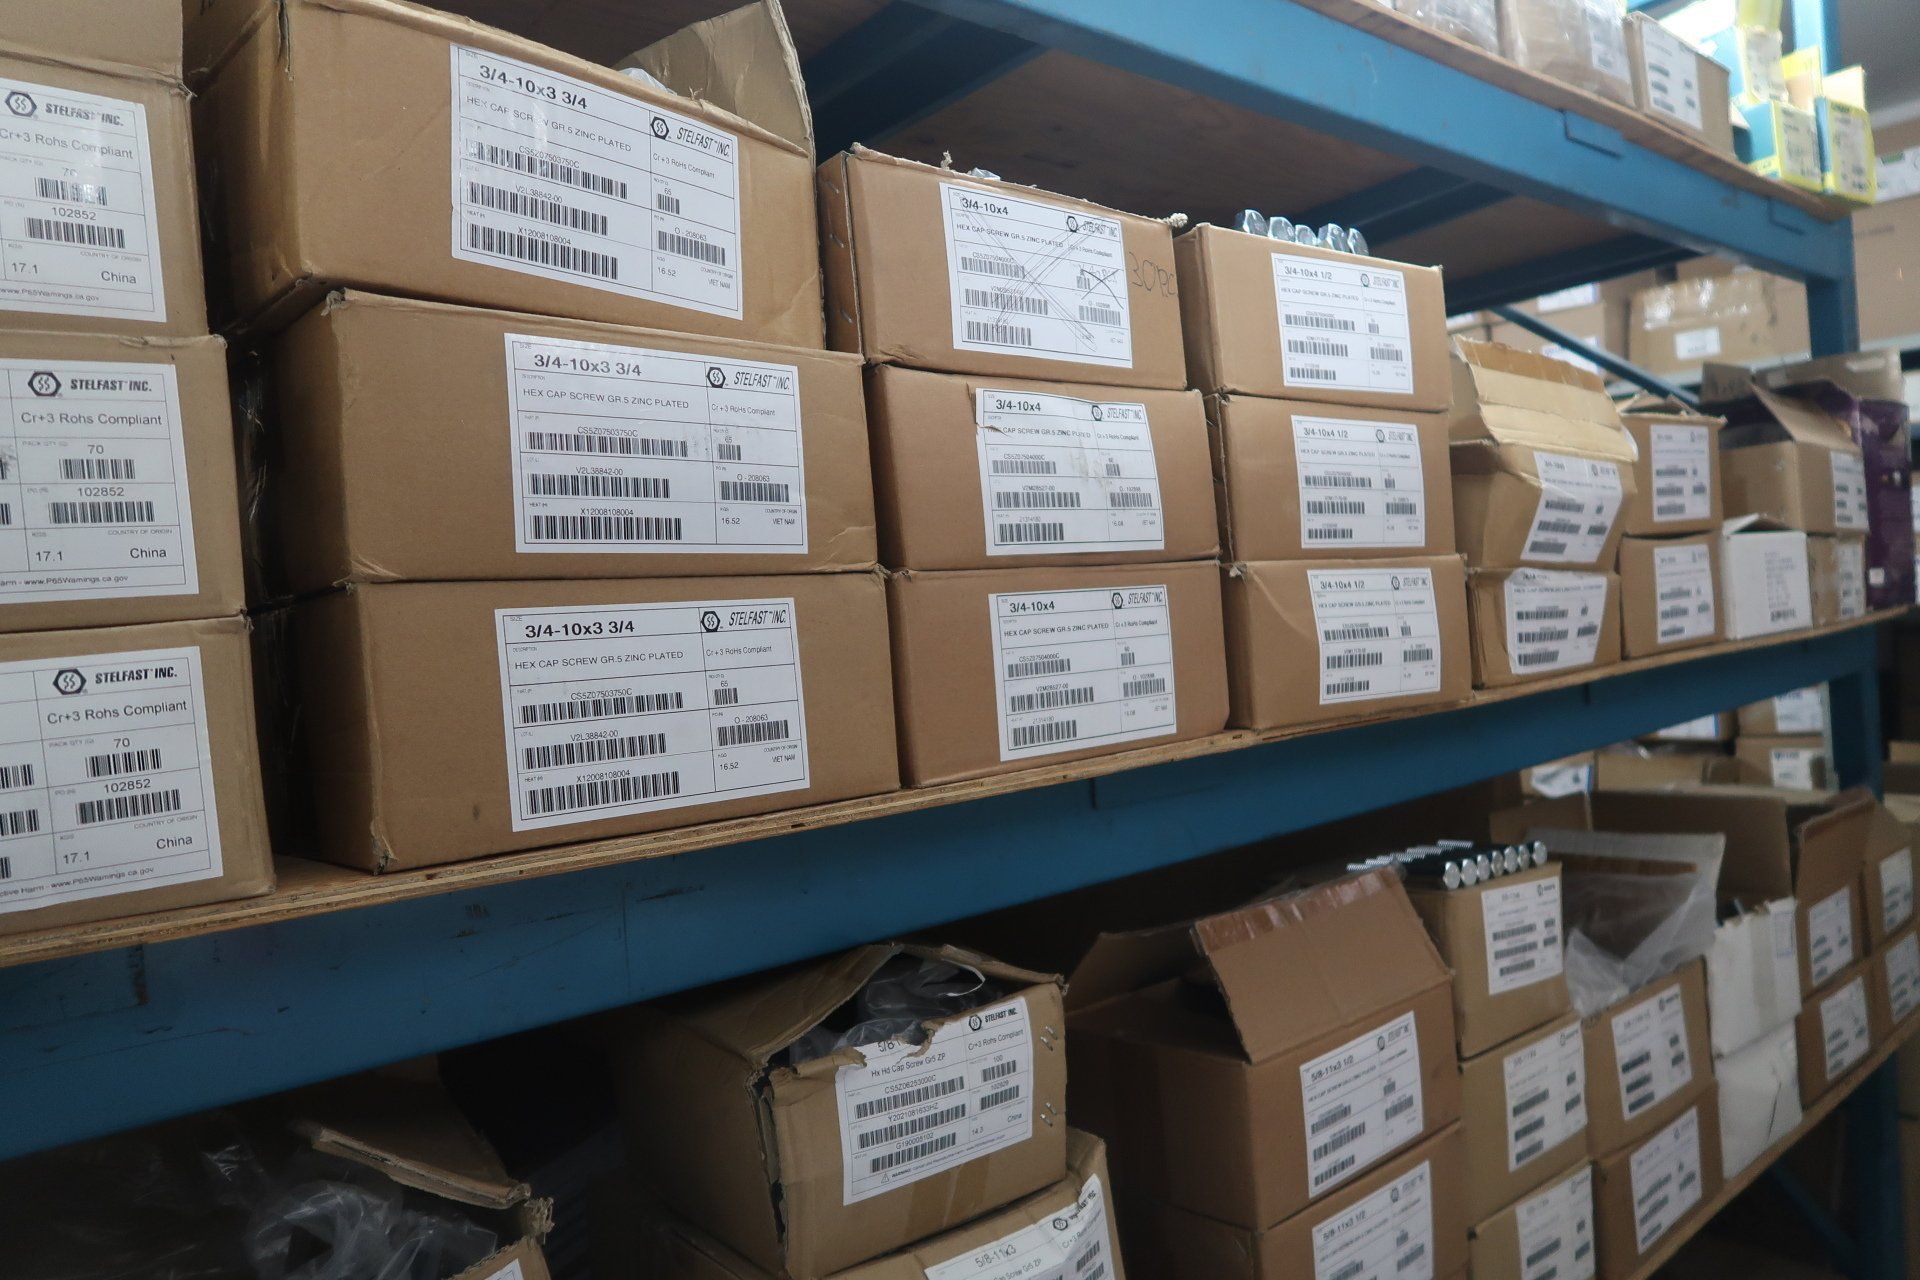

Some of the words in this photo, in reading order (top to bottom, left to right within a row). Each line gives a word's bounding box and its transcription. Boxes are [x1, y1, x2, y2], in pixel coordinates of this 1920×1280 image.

[480, 65, 556, 100] 3/4-10x3
[562, 91, 587, 109] 3/4
[101, 112, 124, 127] INC.
[467, 95, 488, 108] HEX
[575, 127, 596, 141] ZINC
[598, 135, 631, 152] PLATED
[35, 133, 68, 149] Rohs
[71, 138, 133, 159] Compliant
[677, 127, 714, 150] STELFAST
[716, 140, 730, 157] INC.
[653, 153, 661, 161] Cr
[671, 160, 687, 170] RoHs
[688, 164, 715, 179] Compliant
[962, 197, 1008, 216] 3/4-10x4
[51, 206, 96, 221] 102852
[957, 223, 970, 231] HEX
[987, 228, 1009, 238] SCREW
[1026, 236, 1040, 244] ZINC
[12, 262, 38, 274] 17.1
[657, 267, 676, 277] 16.52
[1285, 266, 1318, 278] 3/4-10x4
[1321, 271, 1332, 280] 1/2
[101, 270, 137, 284] China
[534, 354, 611, 373] 3/4-10x3
[616, 362, 642, 376] 3/4
[70, 379, 123, 391] STELFAST
[129, 380, 152, 392] INC.
[734, 371, 772, 388] STELFAST
[776, 377, 790, 390] INC.
[524, 389, 544, 397] HEX
[547, 390, 567, 398] CAP
[570, 391, 605, 402] SCREW
[632, 397, 653, 406] ZINC
[655, 399, 689, 408] PLATED
[730, 406, 746, 414] RoHs
[747, 407, 775, 416] Compliant
[996, 399, 1041, 412] 3/4-10x4
[21, 413, 54, 424] Cr+3
[59, 413, 94, 424] Rohs
[98, 414, 162, 426] Compliant
[1107, 408, 1130, 419] STELFAST
[1304, 428, 1335, 436] 3/4-10x4
[1338, 429, 1348, 438] 1/2
[88, 445, 104, 454] 70
[748, 474, 770, 482] 208063
[78, 488, 125, 497] 102852
[581, 507, 634, 516] X12008108004
[35, 551, 64, 561] 17.1
[130, 548, 167, 559] China
[1321, 581, 1352, 589] 3/4-10x4
[1128, 593, 1151, 605] STELFAST
[1010, 601, 1055, 613] 3/4-10x4
[729, 611, 768, 627] STELFAST
[771, 610, 786, 623] INC.
[525, 621, 603, 639] 3/4-10x3
[608, 620, 635, 634] 3/4
[1033, 627, 1055, 635] SCREW
[706, 649, 713, 657] Cr
[725, 647, 742, 655] RoHs
[743, 646, 772, 654] Compliant
[515, 662, 536, 670] HEX
[539, 659, 559, 669] CAP
[562, 656, 599, 667] SCREW
[625, 653, 646, 662] ZINC
[648, 651, 683, 660] PLATED
[95, 669, 150, 684] STELFAST
[155, 667, 177, 679] INC.
[47, 711, 81, 724] Cr+3
[85, 707, 119, 720] Rohs
[123, 700, 187, 717] Compliant
[746, 714, 769, 723] 208063
[570, 730, 619, 742] V2L38842-00
[114, 738, 130, 748] 70
[784, 754, 795, 762] NAM
[720, 762, 739, 771] 16.52
[576, 770, 630, 782] X12008108004
[104, 779, 151, 793] 102852
[157, 835, 193, 849] China
[63, 851, 90, 864] 17.1
[985, 1010, 1006, 1022] STELFAST
[871, 1069, 880, 1077] Hx
[892, 1062, 904, 1073] Cap
[905, 1059, 924, 1070] Screw
[937, 1053, 945, 1061] ZP
